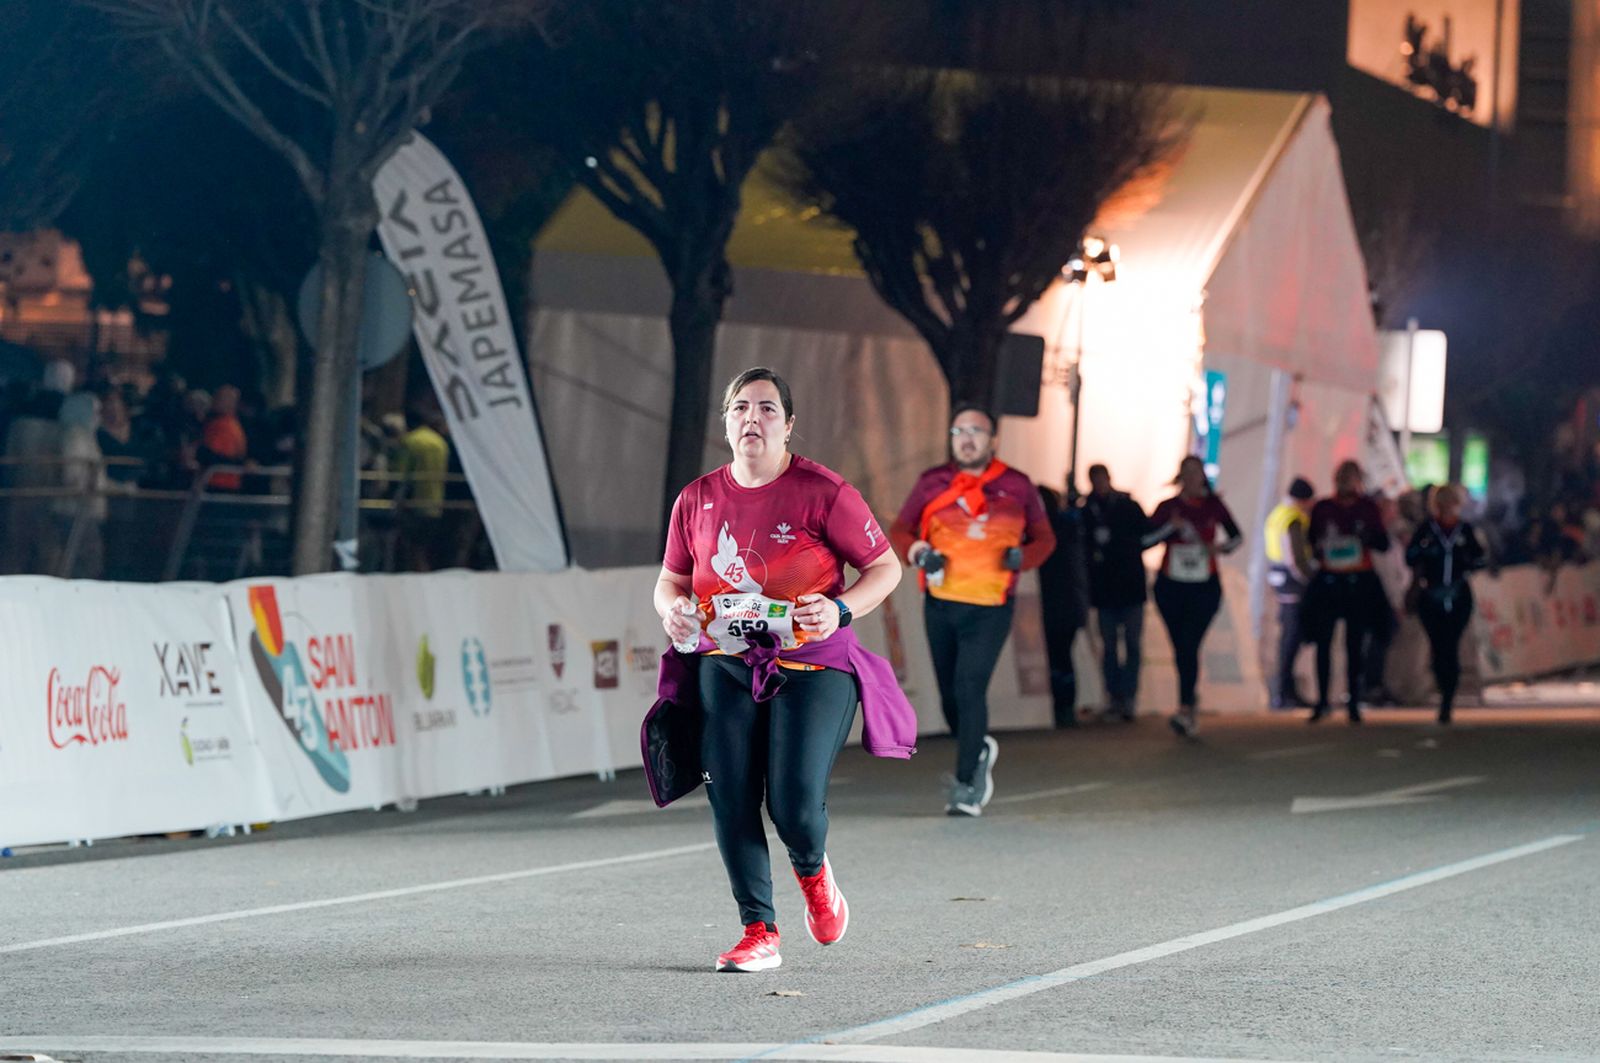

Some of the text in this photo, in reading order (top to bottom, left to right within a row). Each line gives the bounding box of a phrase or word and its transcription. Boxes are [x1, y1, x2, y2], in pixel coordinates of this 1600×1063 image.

[424, 179, 522, 409] JAPEMASA
[723, 562, 744, 584] 43
[308, 634, 356, 690] SAN
[282, 664, 318, 751] 43
[324, 694, 396, 752] ANTON
